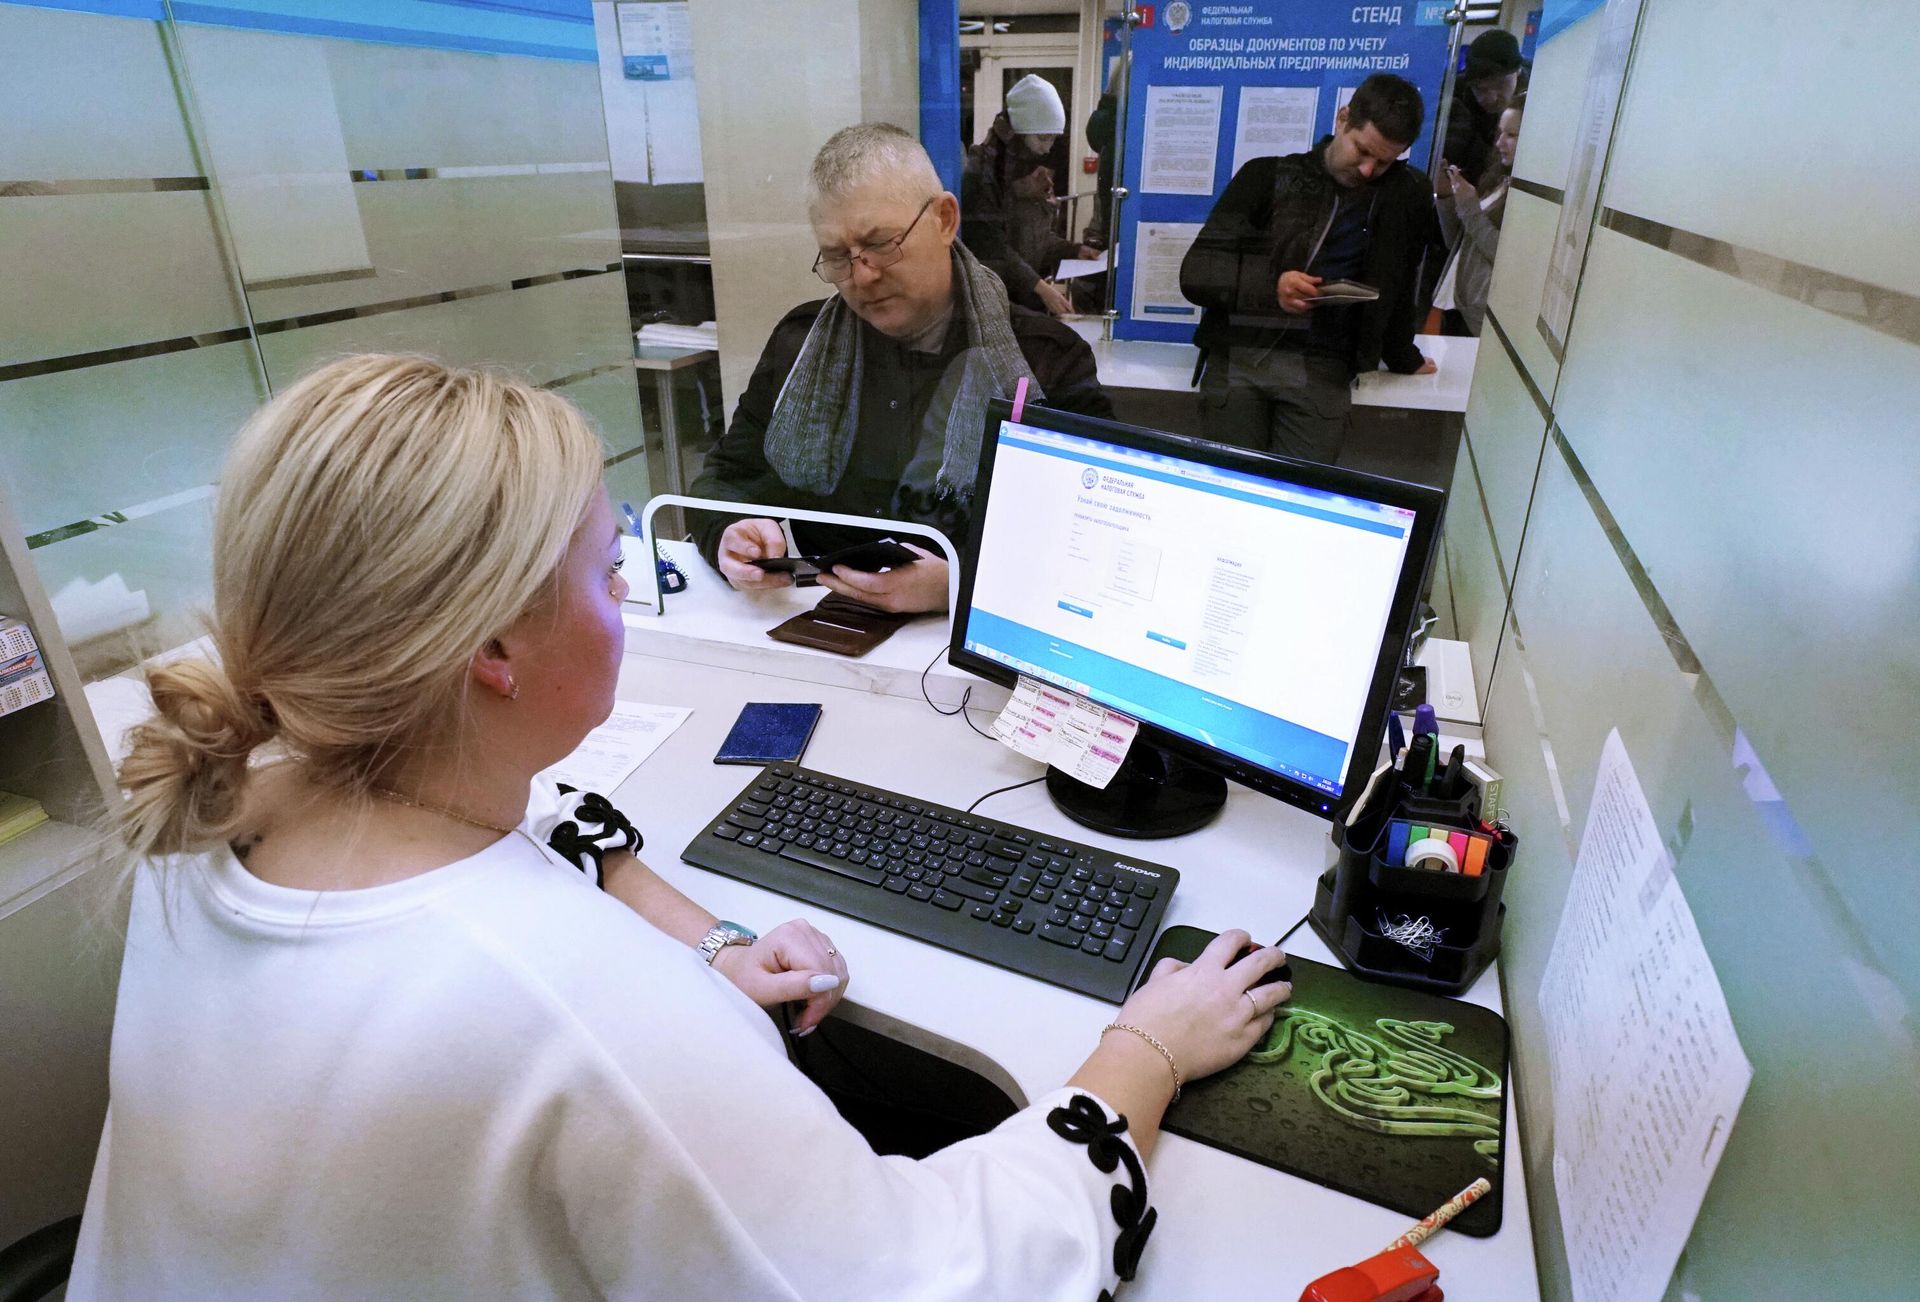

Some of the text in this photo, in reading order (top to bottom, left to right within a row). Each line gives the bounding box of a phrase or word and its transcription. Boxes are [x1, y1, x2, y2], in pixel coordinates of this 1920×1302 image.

[1202, 6, 1254, 15] ФЕДЕРАЛЬНАЯ
[1351, 6, 1402, 26] СТЕНД
[1201, 16, 1273, 25] НАЛОГОВАЯ СЛУЖБА
[1188, 38, 1387, 53] ОБРАЗЦЫ ДОКУМЕНТОВ ПО УЧЕТУ
[1163, 53, 1410, 71] ИНДИВИДУАЛЬНЫХ ПРЕДПРИНИМАТЕЛЕЙ
[1114, 861, 1161, 878] lenovo
